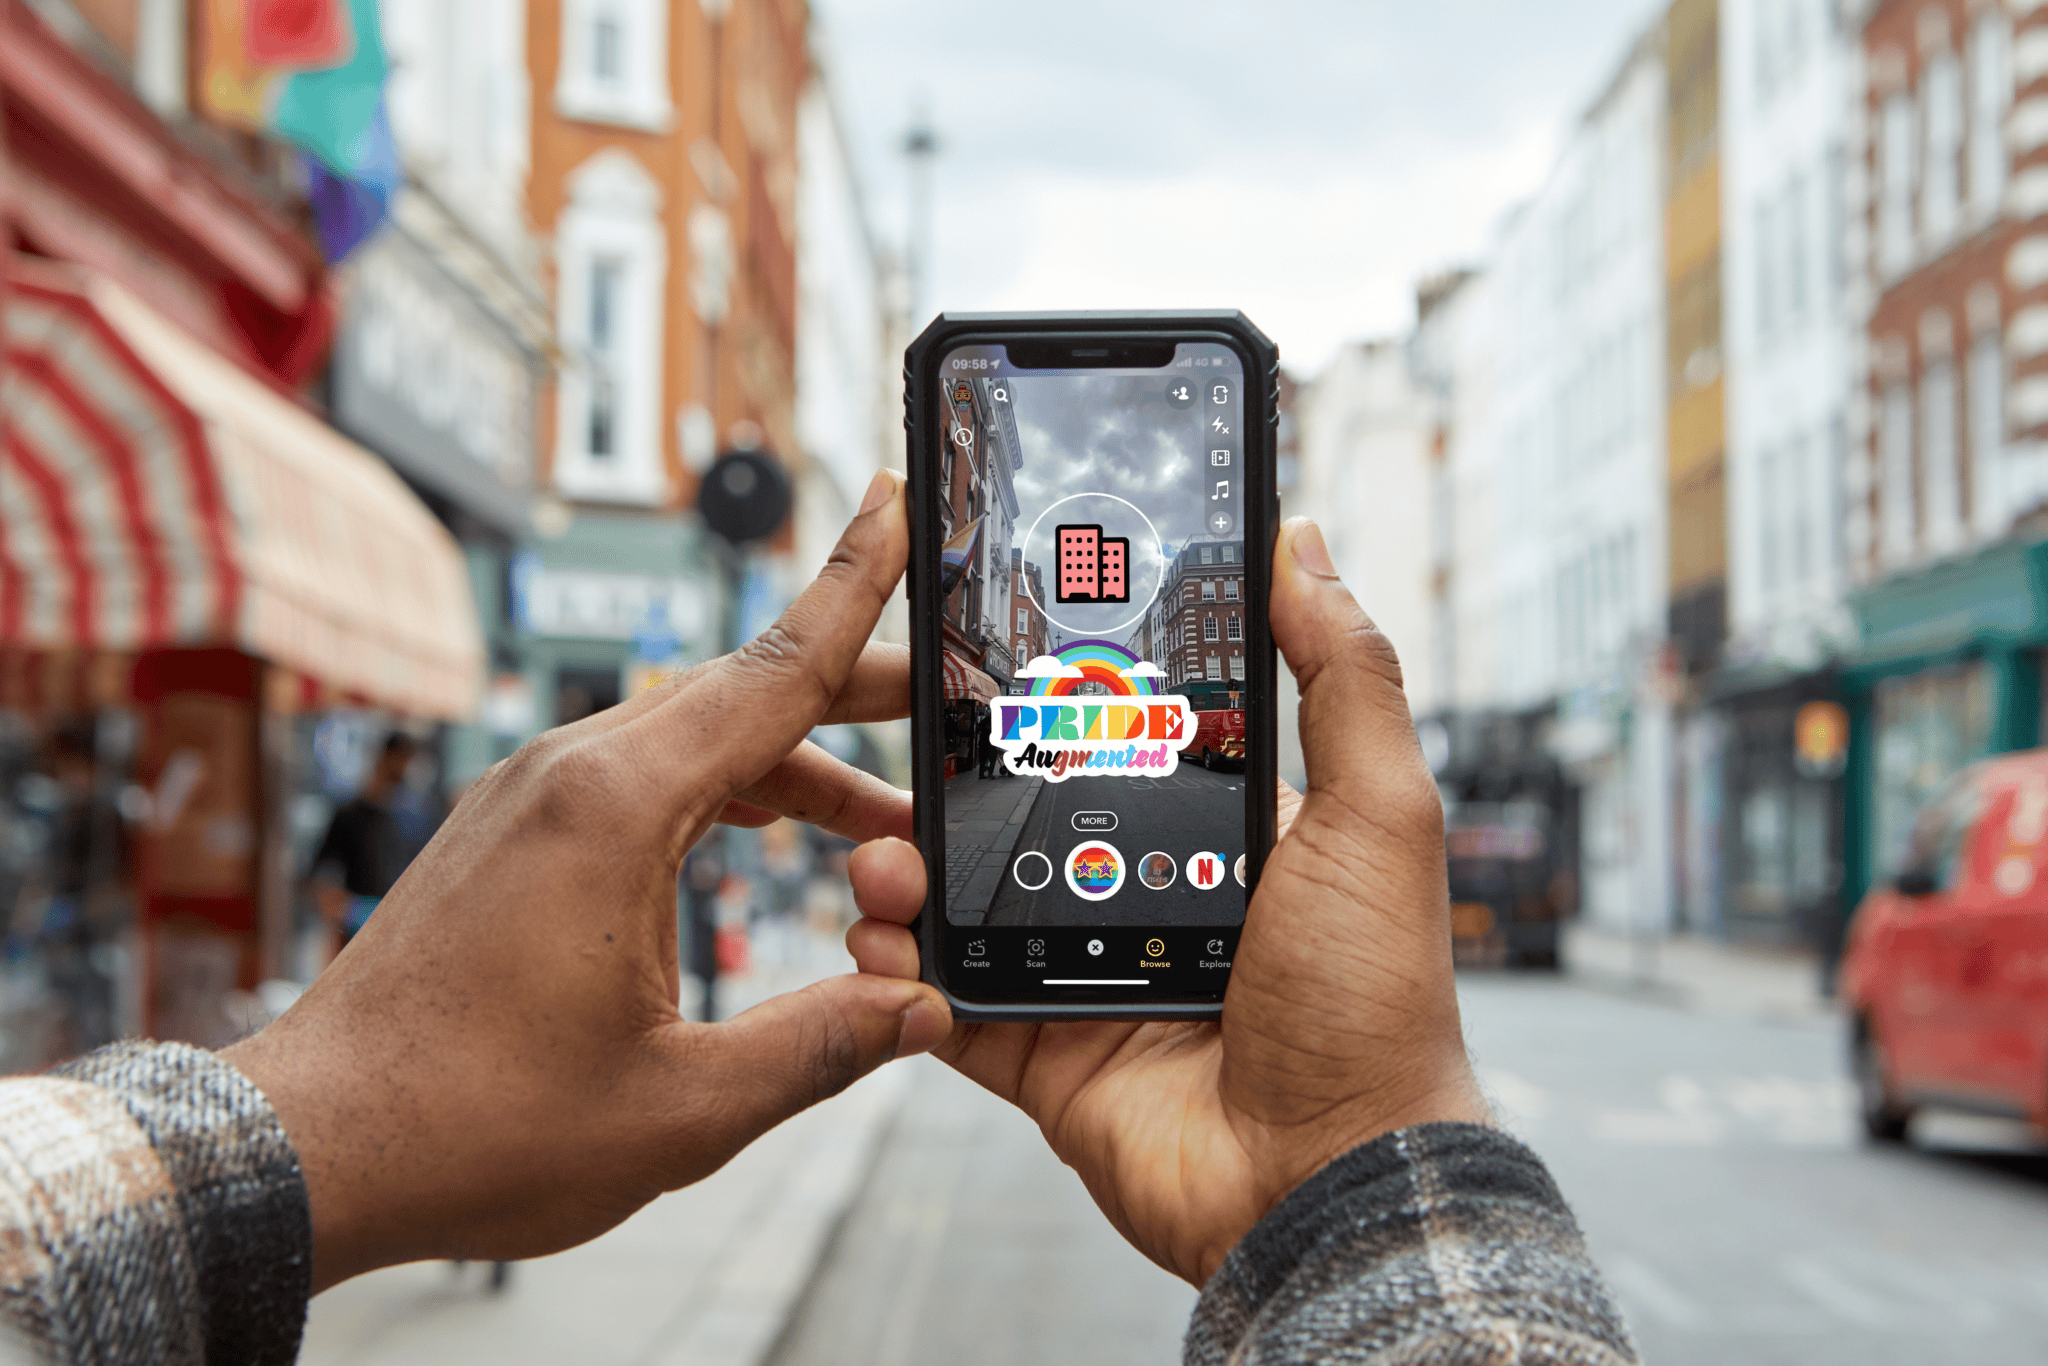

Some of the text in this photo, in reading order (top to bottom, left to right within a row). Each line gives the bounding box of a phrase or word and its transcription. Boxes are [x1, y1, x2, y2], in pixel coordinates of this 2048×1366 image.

[952, 358, 988, 370] 09:58
[1194, 357, 1209, 367] 4G
[1000, 705, 1184, 740] PRIDE
[1014, 742, 1168, 777] Augmented
[1081, 817, 1108, 825] MORE
[1197, 858, 1213, 885] N
[963, 959, 991, 968] Create
[1026, 959, 1046, 968] Scan
[1140, 959, 1171, 968] Browse
[1199, 959, 1232, 970] Explore
